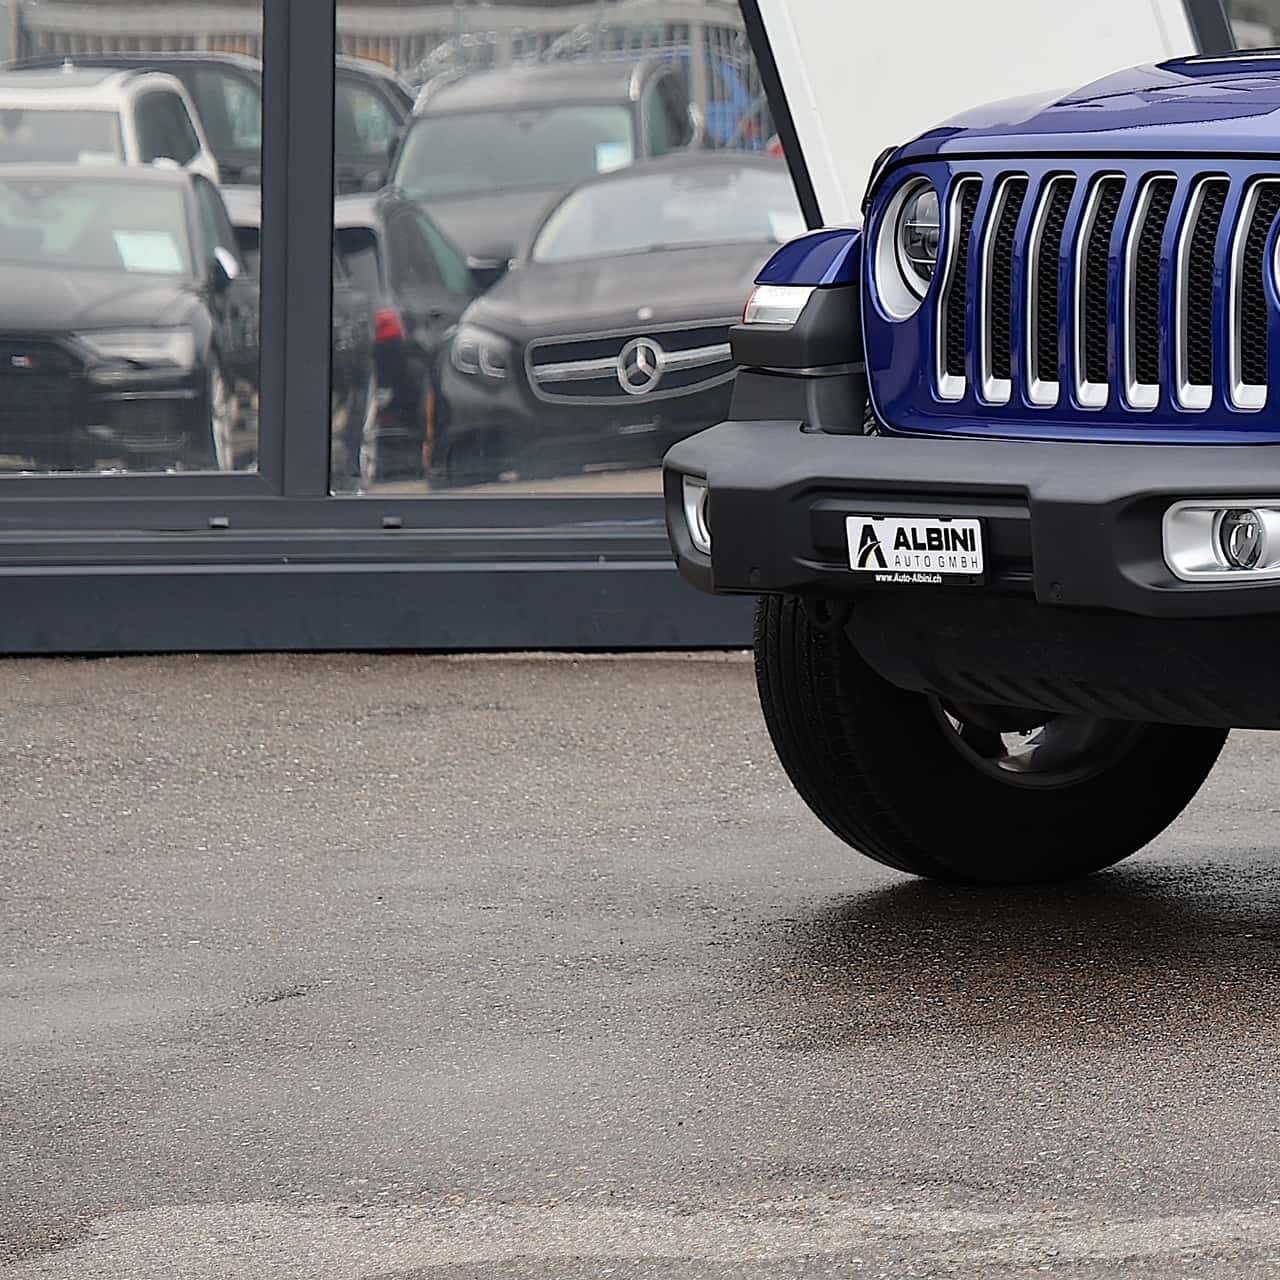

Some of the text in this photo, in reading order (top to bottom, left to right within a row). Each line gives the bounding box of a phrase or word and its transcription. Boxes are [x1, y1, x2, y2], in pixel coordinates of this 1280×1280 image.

[893, 527, 977, 552] ALBINI
[894, 555, 978, 569] AUTO GMBH
[874, 573, 942, 583] www.Auto-Albini.ch
